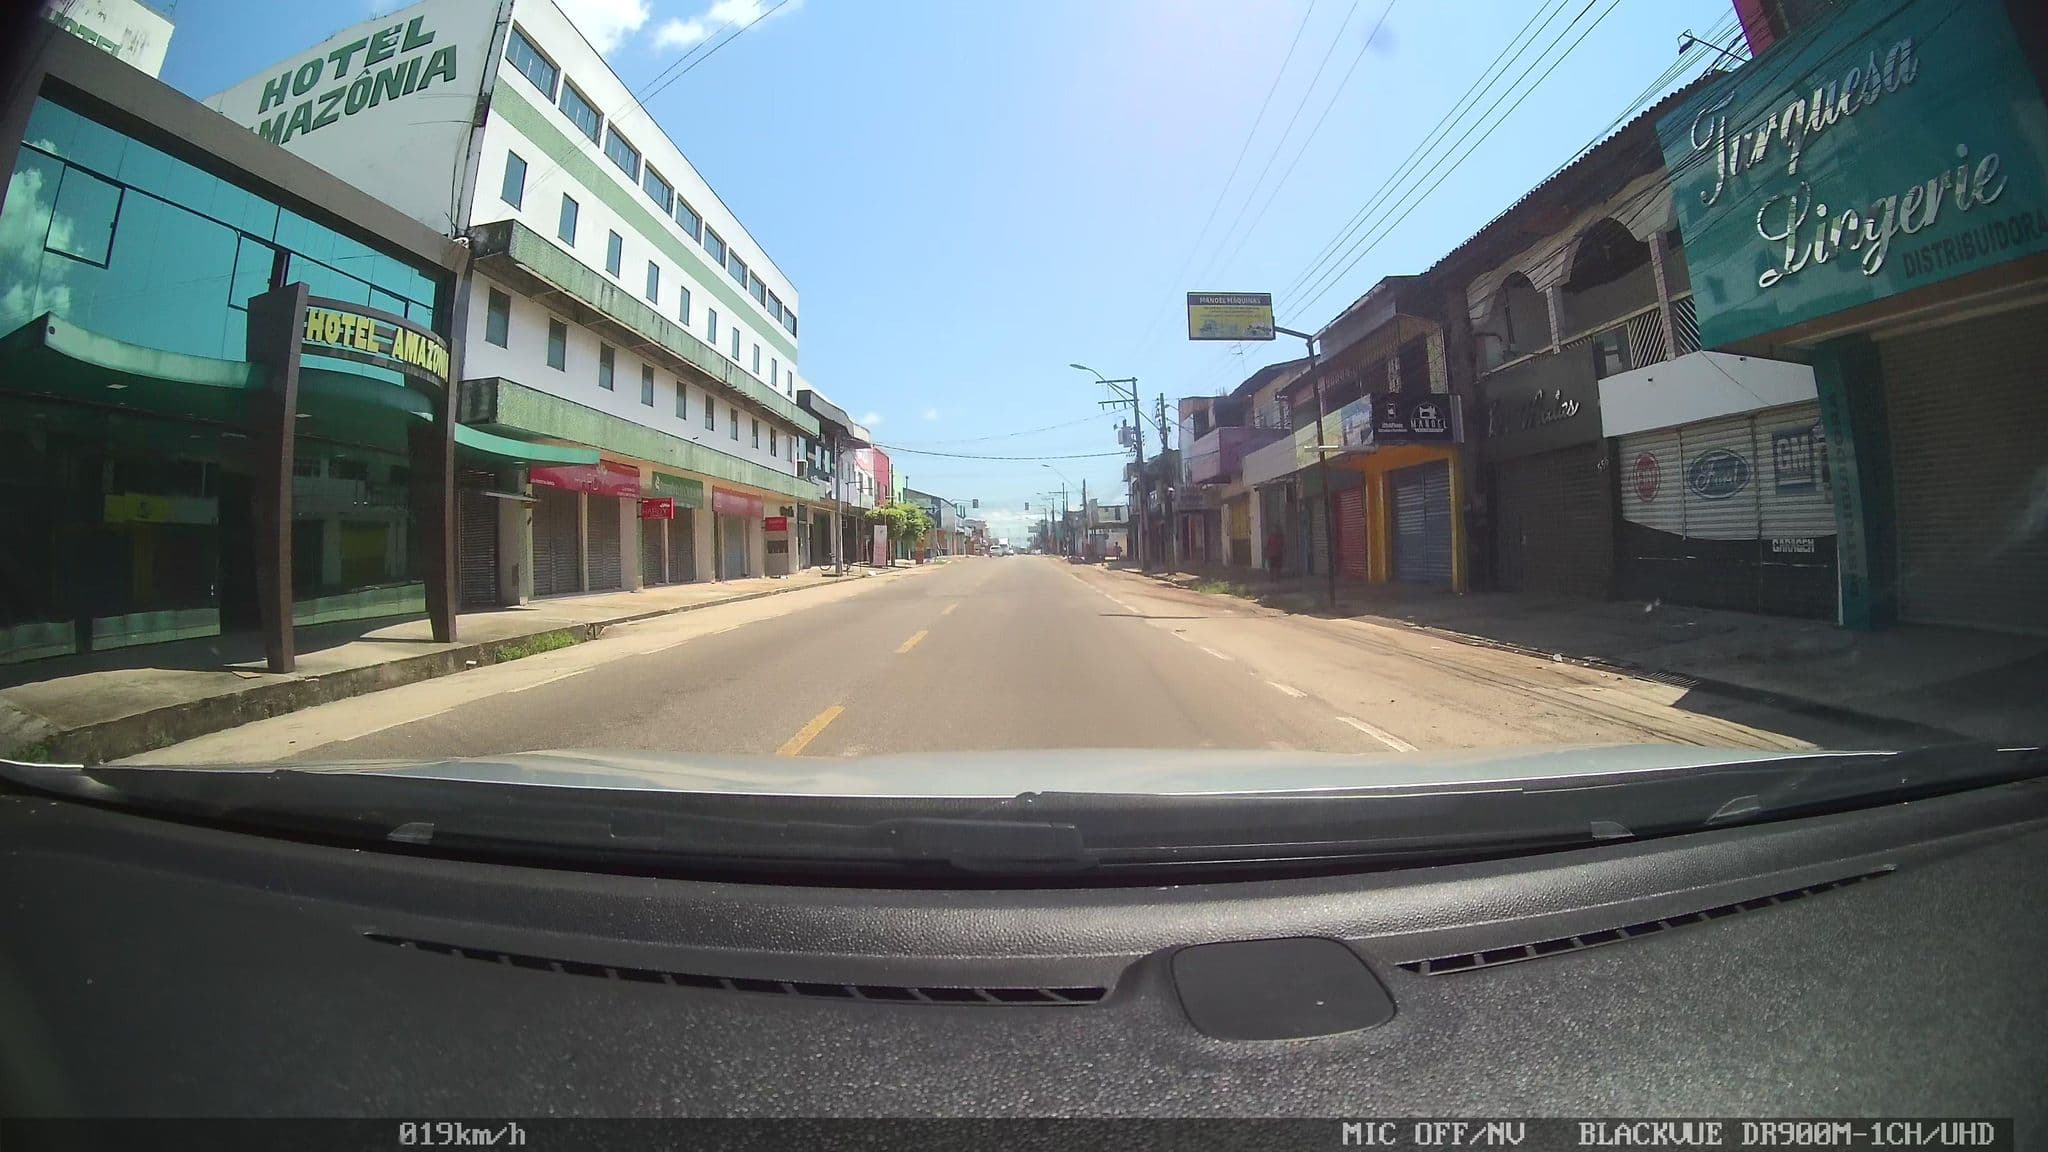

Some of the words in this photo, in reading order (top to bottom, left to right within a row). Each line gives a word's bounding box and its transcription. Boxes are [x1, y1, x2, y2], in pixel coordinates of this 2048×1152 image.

[258, 15, 436, 114] HOTEL
[249, 45, 457, 146] MAZÔNIA
[1756, 142, 2008, 288] Lingerie
[1904, 206, 2048, 279] DISTRIBUIDORA
[1200, 296, 1226, 304] MANOEL
[306, 306, 381, 354] HOTEL
[1410, 418, 1449, 429] MANOEL
[1696, 457, 1740, 492] Ford
[1776, 437, 1811, 471] GM
